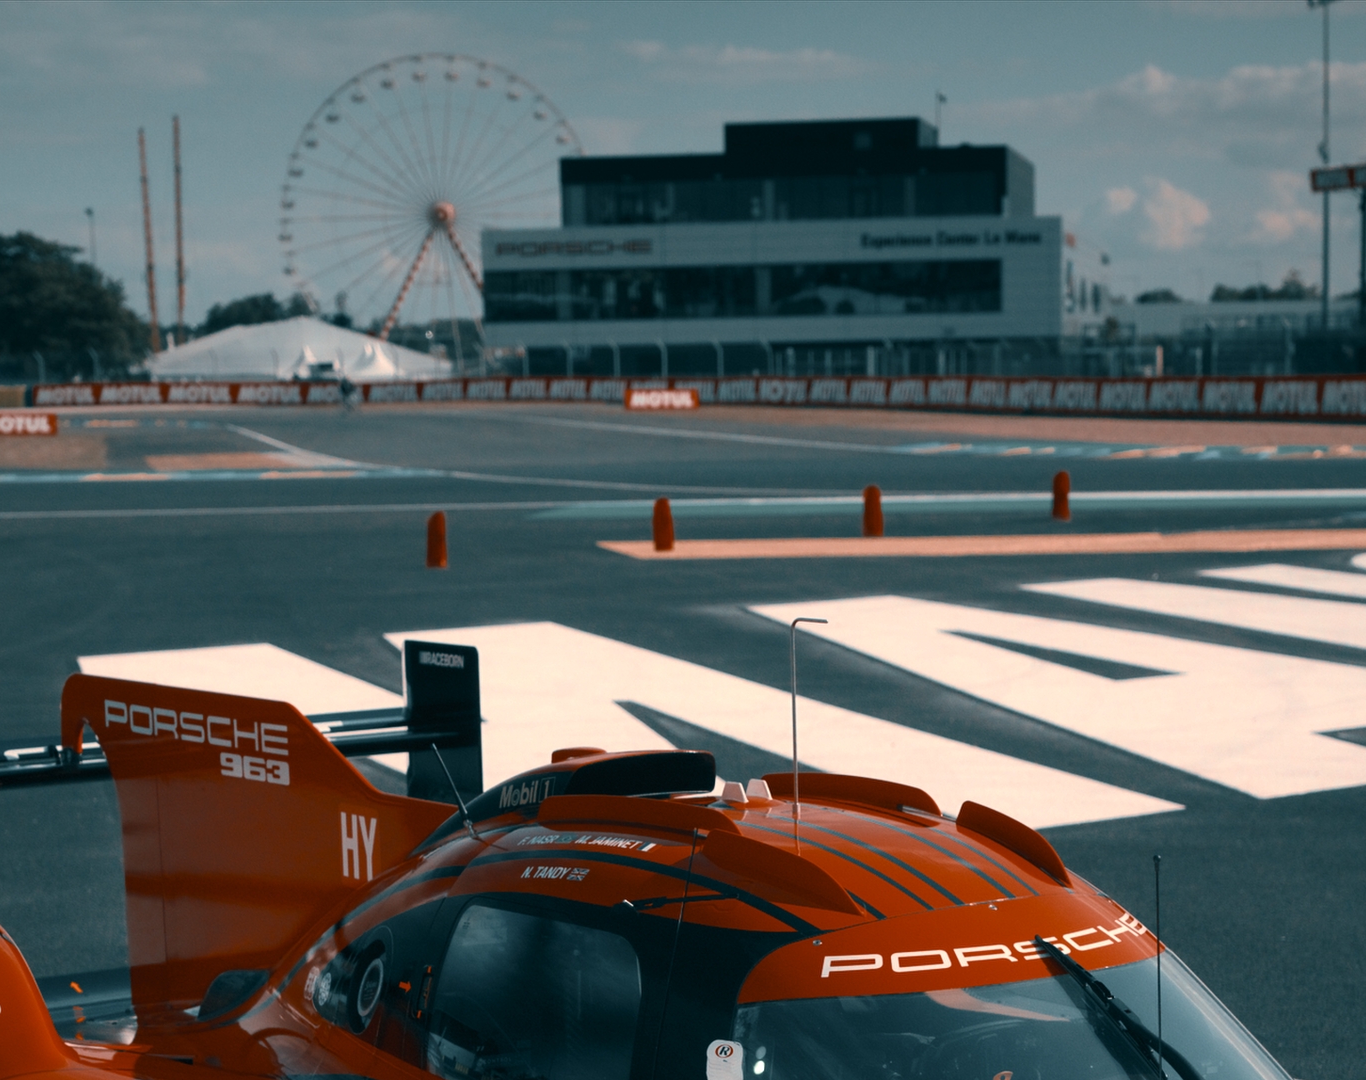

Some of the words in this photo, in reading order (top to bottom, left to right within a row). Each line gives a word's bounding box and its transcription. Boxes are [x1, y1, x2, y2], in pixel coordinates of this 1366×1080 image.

[497, 240, 652, 257] PORSCHE
[861, 233, 932, 250] Experience
[629, 389, 695, 409] MOTUL
[104, 699, 290, 757] PORSCHE
[219, 751, 291, 786] 963
[498, 778, 539, 809] Mobil
[339, 810, 378, 882] HY
[588, 836, 643, 850] JAMINET
[520, 866, 533, 879] N.
[533, 866, 572, 879] TANDY
[820, 911, 1148, 979] PORSCHE
